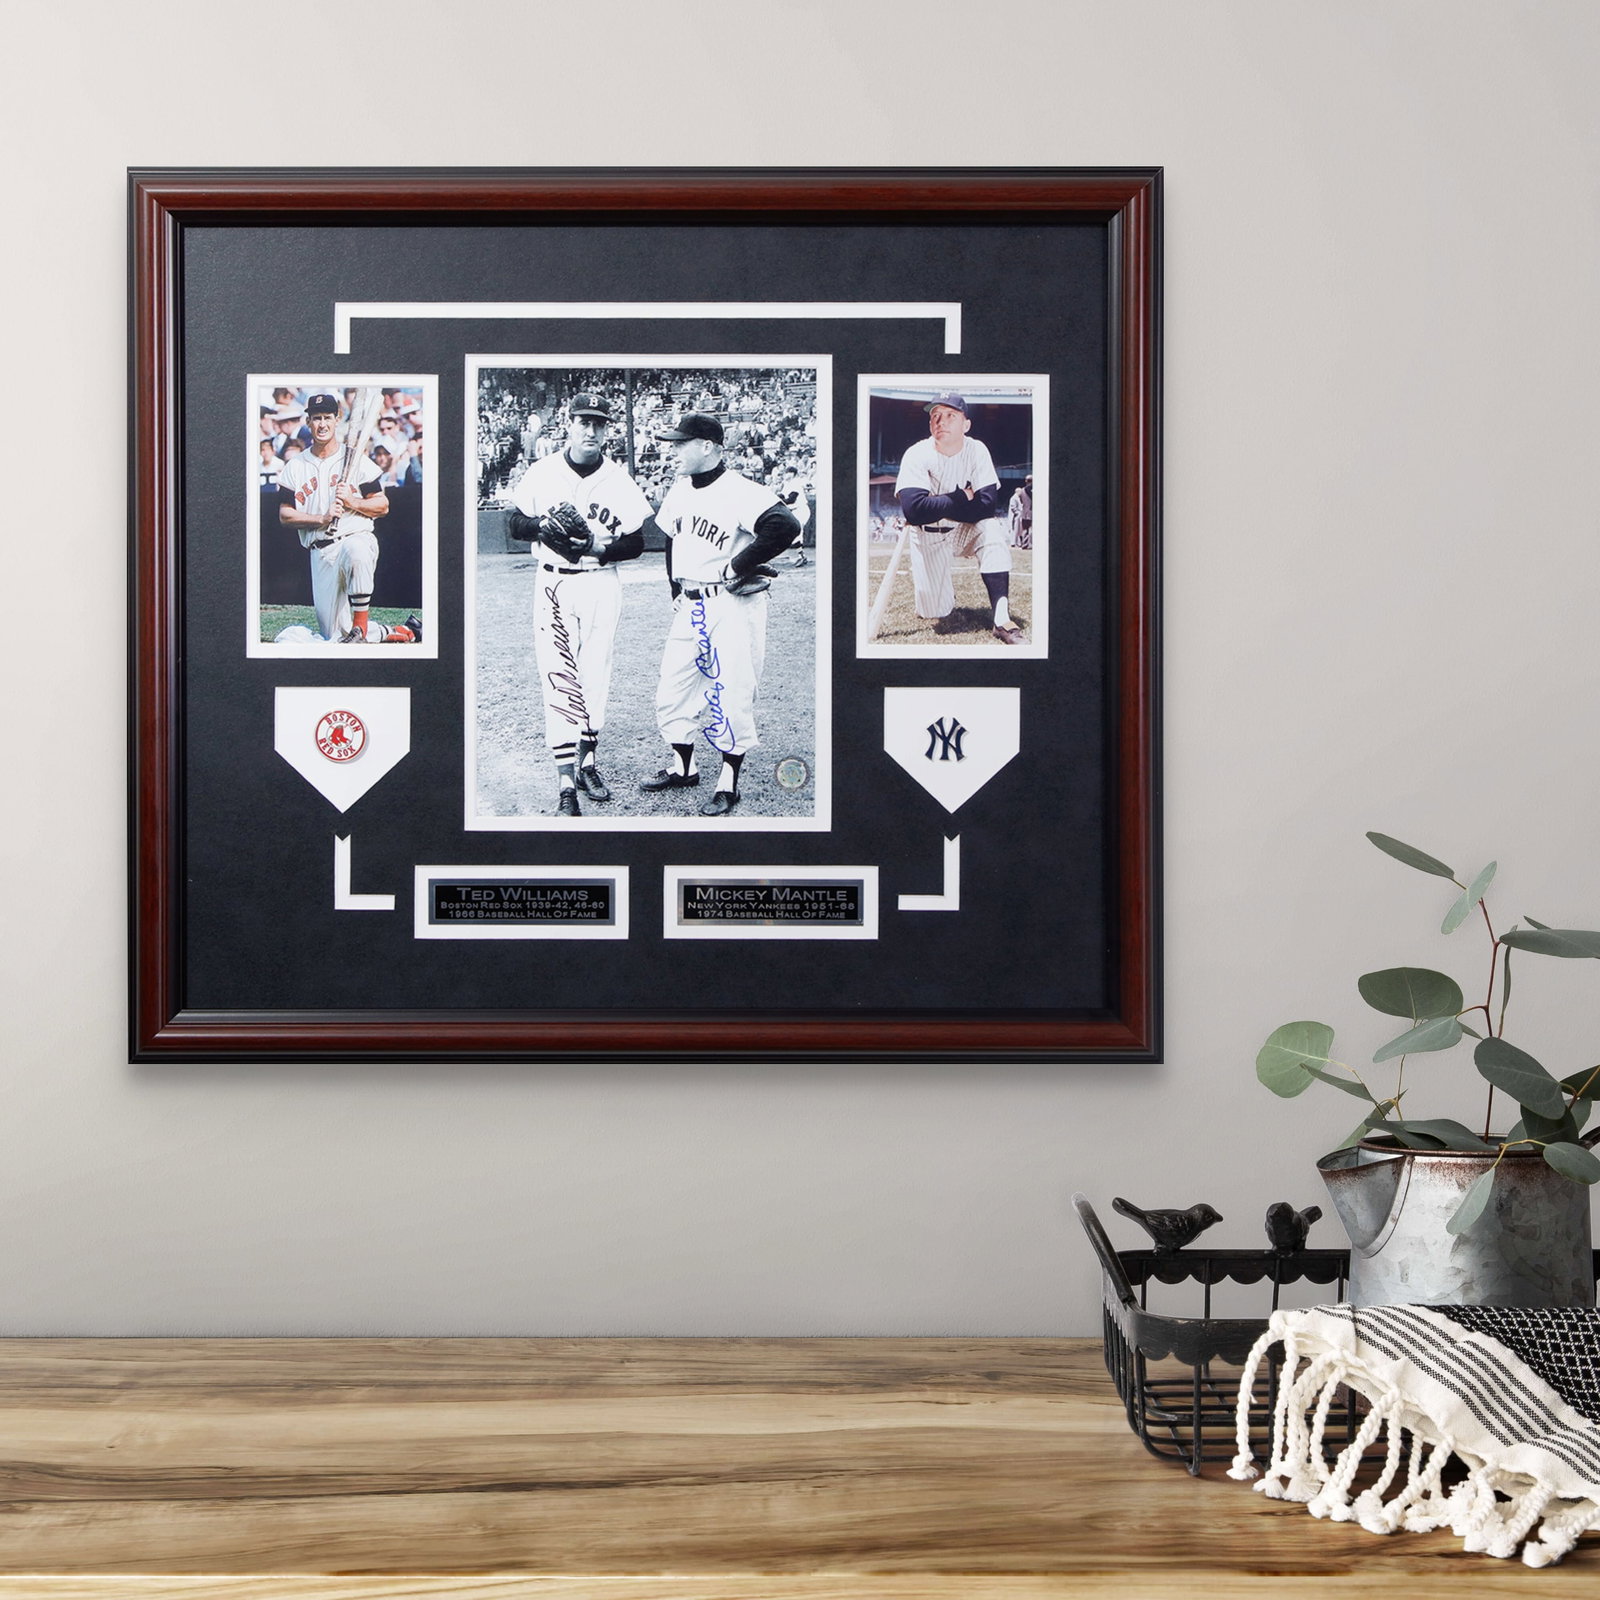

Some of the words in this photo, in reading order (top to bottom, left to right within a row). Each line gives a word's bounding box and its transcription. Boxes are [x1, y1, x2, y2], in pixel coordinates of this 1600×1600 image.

[587, 502, 622, 536] SOX
[691, 515, 730, 551] YORK
[325, 713, 362, 732] BOSTON
[319, 738, 334, 754] RED
[337, 745, 355, 757] SOX
[456, 887, 496, 901] TED
[499, 887, 589, 901] WILLIAMS
[696, 887, 768, 901] MICKEY
[772, 887, 848, 902] MANTLE
[440, 901, 479, 910] BOSTON
[480, 901, 501, 910] RED
[502, 901, 523, 910] SOX
[687, 901, 714, 909] NEW
[715, 901, 748, 910] YORK
[748, 901, 801, 911] YANKEES
[449, 910, 476, 919] 1966
[477, 910, 526, 919] BASEBALL
[527, 910, 552, 919] HALL
[553, 910, 569, 919] OF
[570, 910, 597, 919] FAME
[697, 910, 724, 919] 1974
[725, 910, 774, 919] BASEBALL
[775, 910, 800, 919] HALL
[801, 910, 817, 919] OF
[818, 910, 846, 919] FAME
